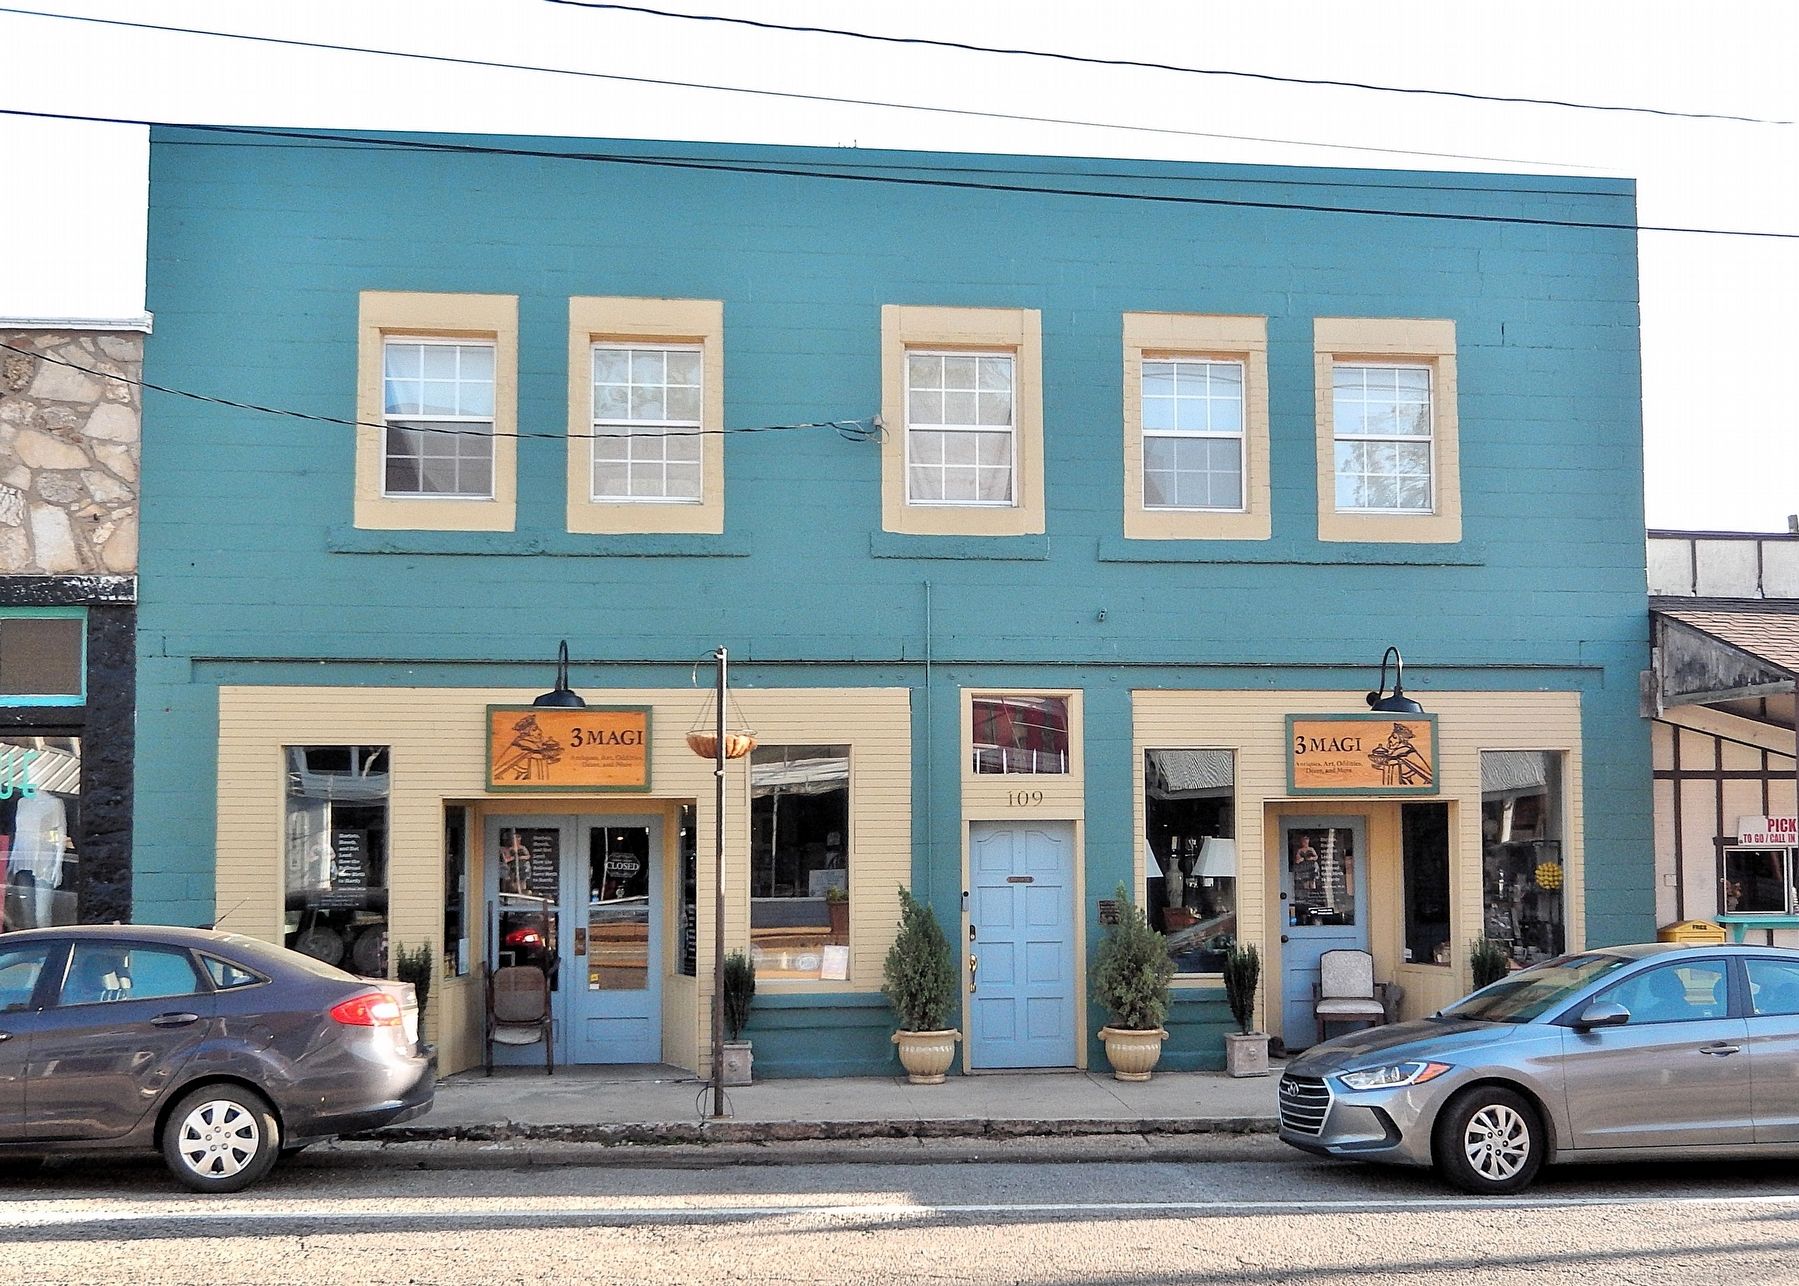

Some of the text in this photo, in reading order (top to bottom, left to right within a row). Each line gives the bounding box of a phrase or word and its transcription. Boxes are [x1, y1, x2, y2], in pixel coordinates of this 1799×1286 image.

[570, 727, 643, 748] 3 MAGI
[1295, 735, 1361, 755] 3 MAGI
[1007, 790, 1044, 808] 109
[1767, 818, 1797, 833] PICK
[1743, 833, 1752, 844] TO
[1754, 833, 1764, 844] GO
[1769, 833, 1786, 844] CALL
[1788, 833, 1796, 844] IN
[606, 861, 640, 871] CLOSED
